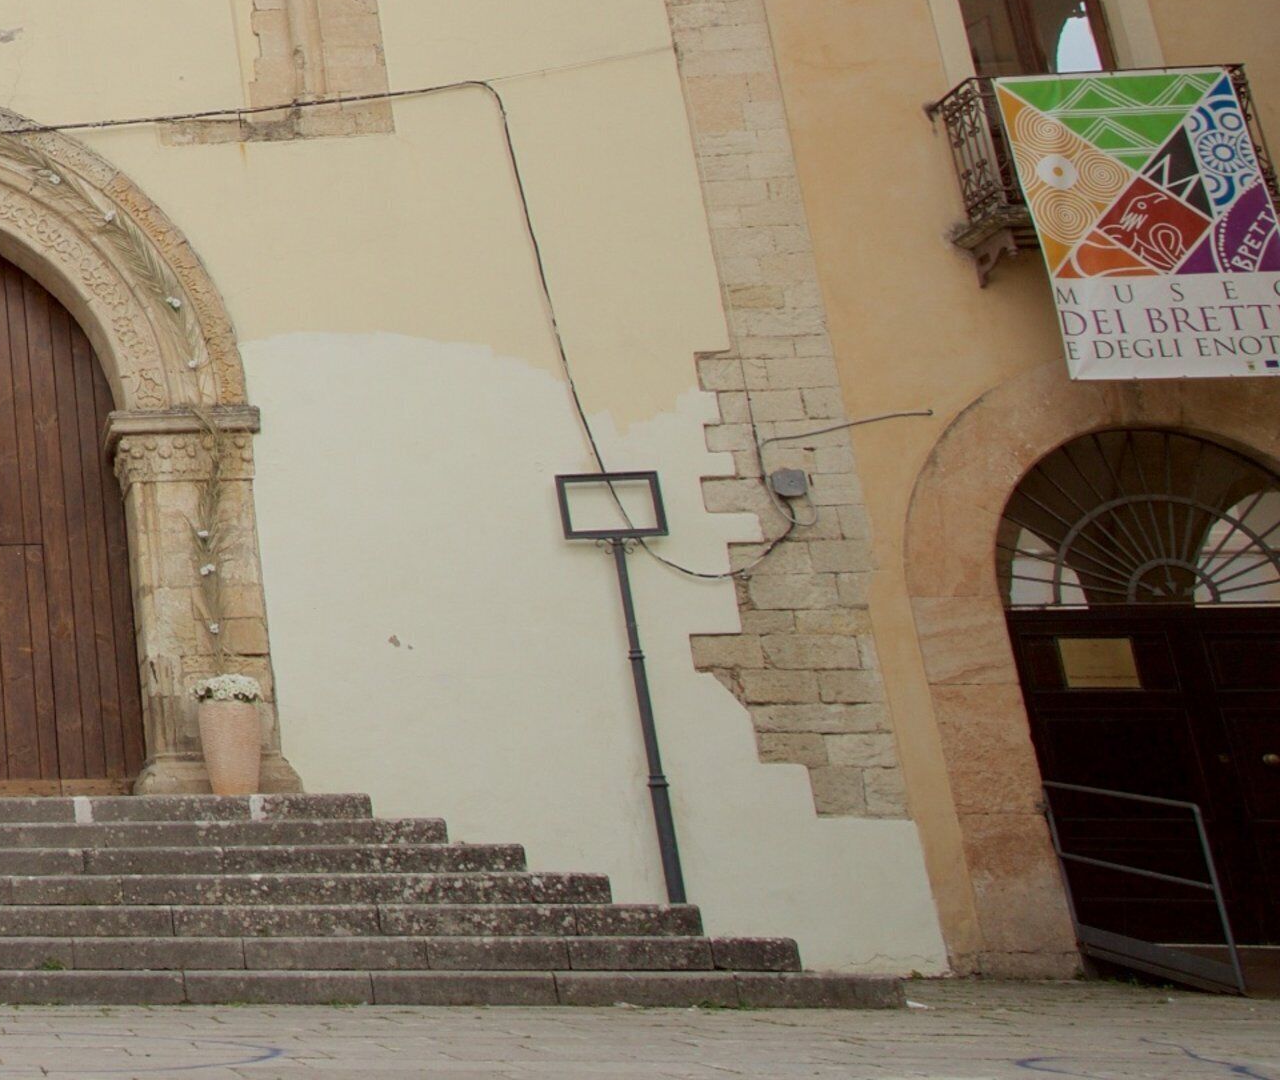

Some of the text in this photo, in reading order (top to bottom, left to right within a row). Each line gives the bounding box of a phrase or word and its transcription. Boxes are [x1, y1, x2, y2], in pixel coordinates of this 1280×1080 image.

[1059, 308, 1128, 337] DEI
[1066, 341, 1081, 360] E
[1093, 338, 1183, 359] DEGLI
